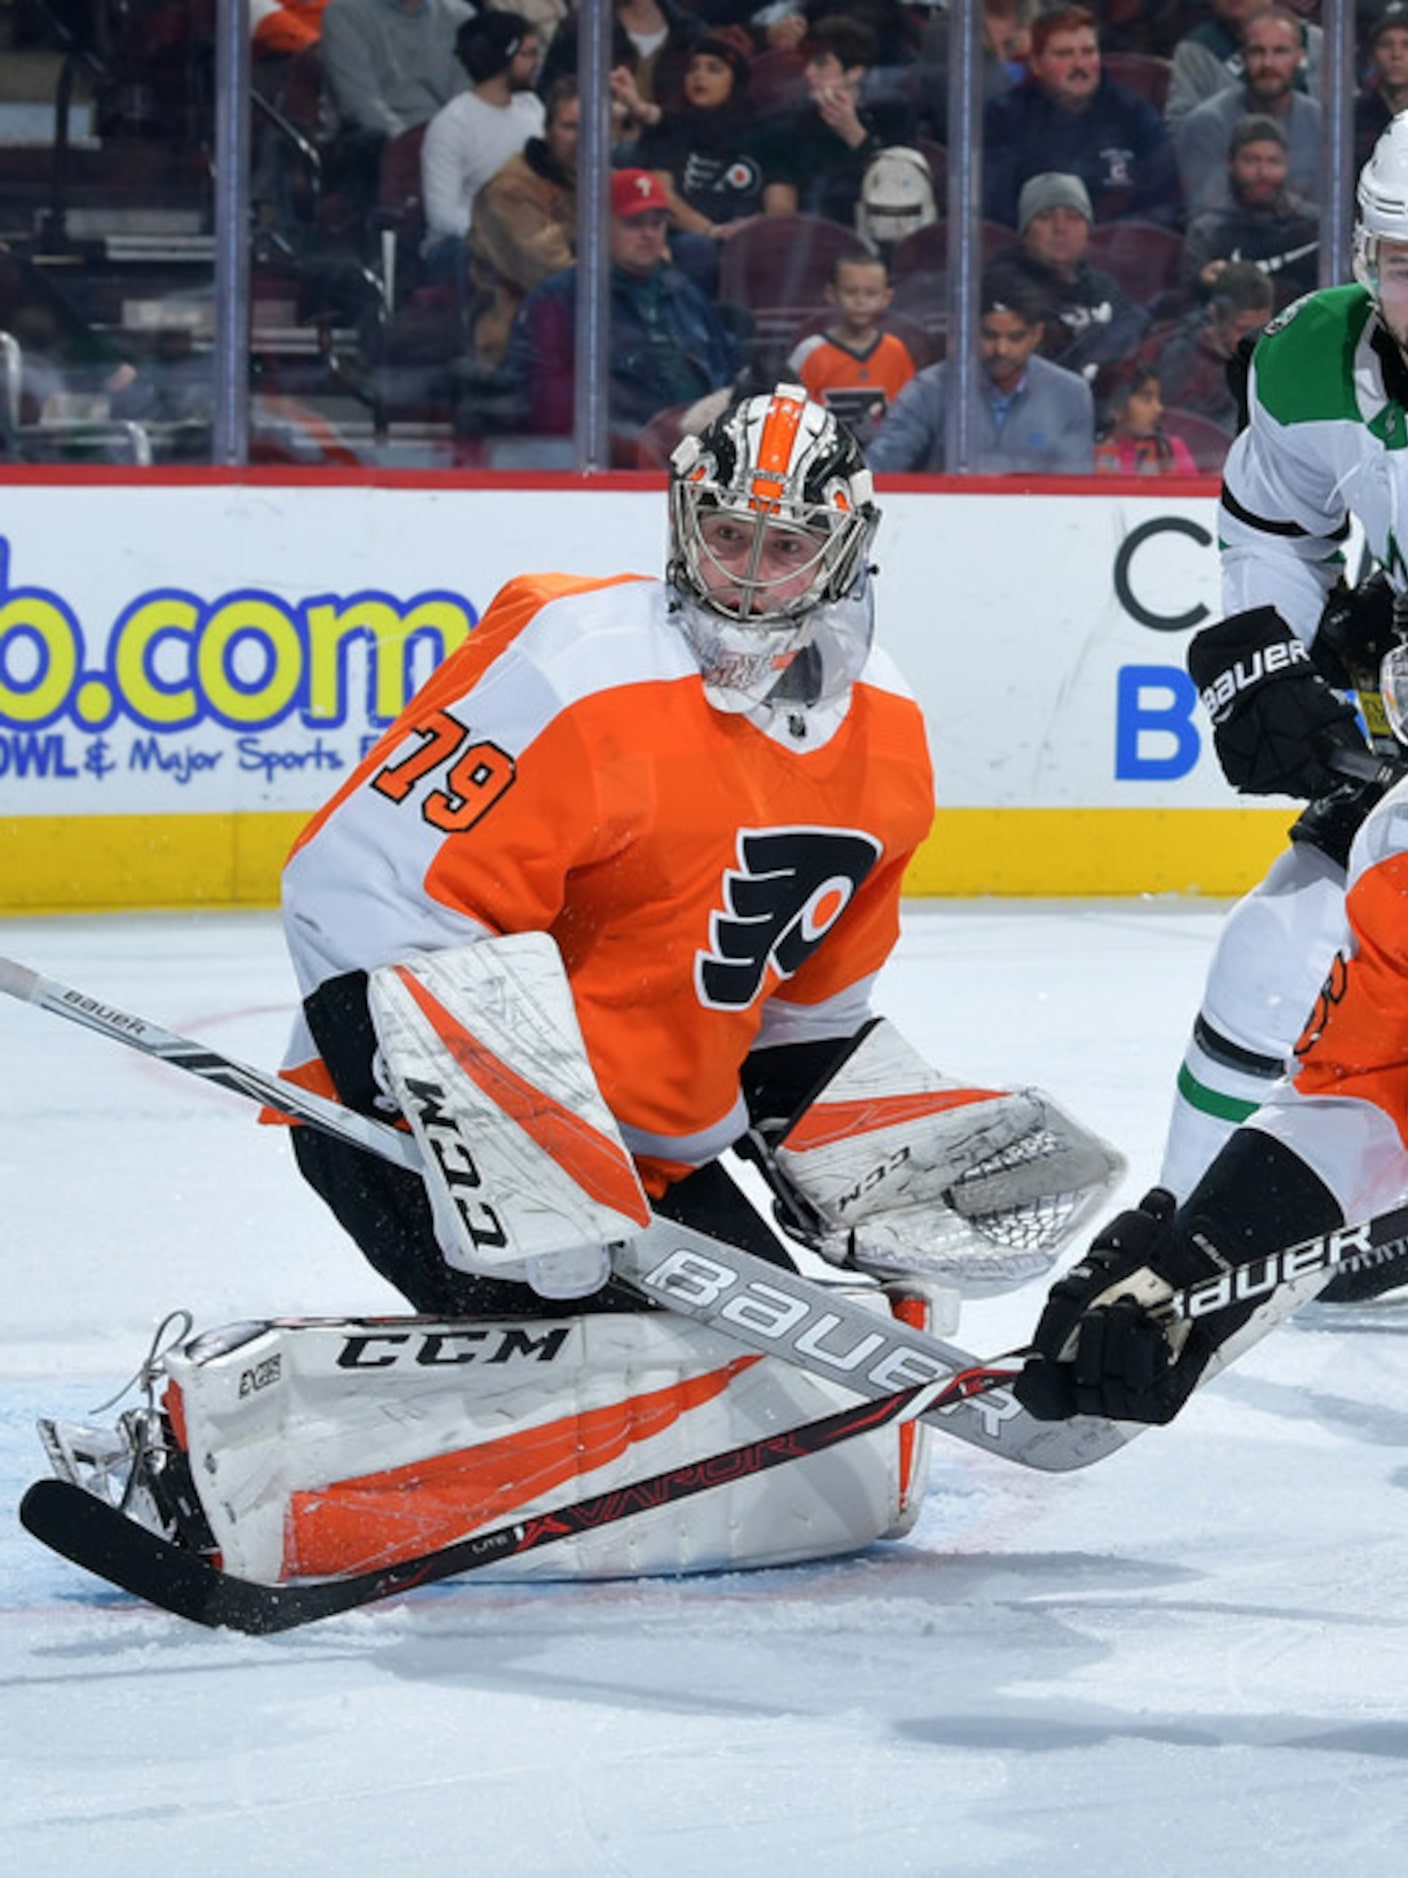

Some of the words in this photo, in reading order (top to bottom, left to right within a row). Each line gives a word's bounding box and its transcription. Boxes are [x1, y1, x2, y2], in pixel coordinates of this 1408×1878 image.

[83, 736, 117, 781] &
[129, 736, 223, 784] Major
[236, 737, 343, 784] Sports
[369, 709, 517, 833] 79
[404, 1077, 509, 1253] CCM
[838, 1145, 911, 1213] CCM
[336, 1327, 571, 1370] CCM
